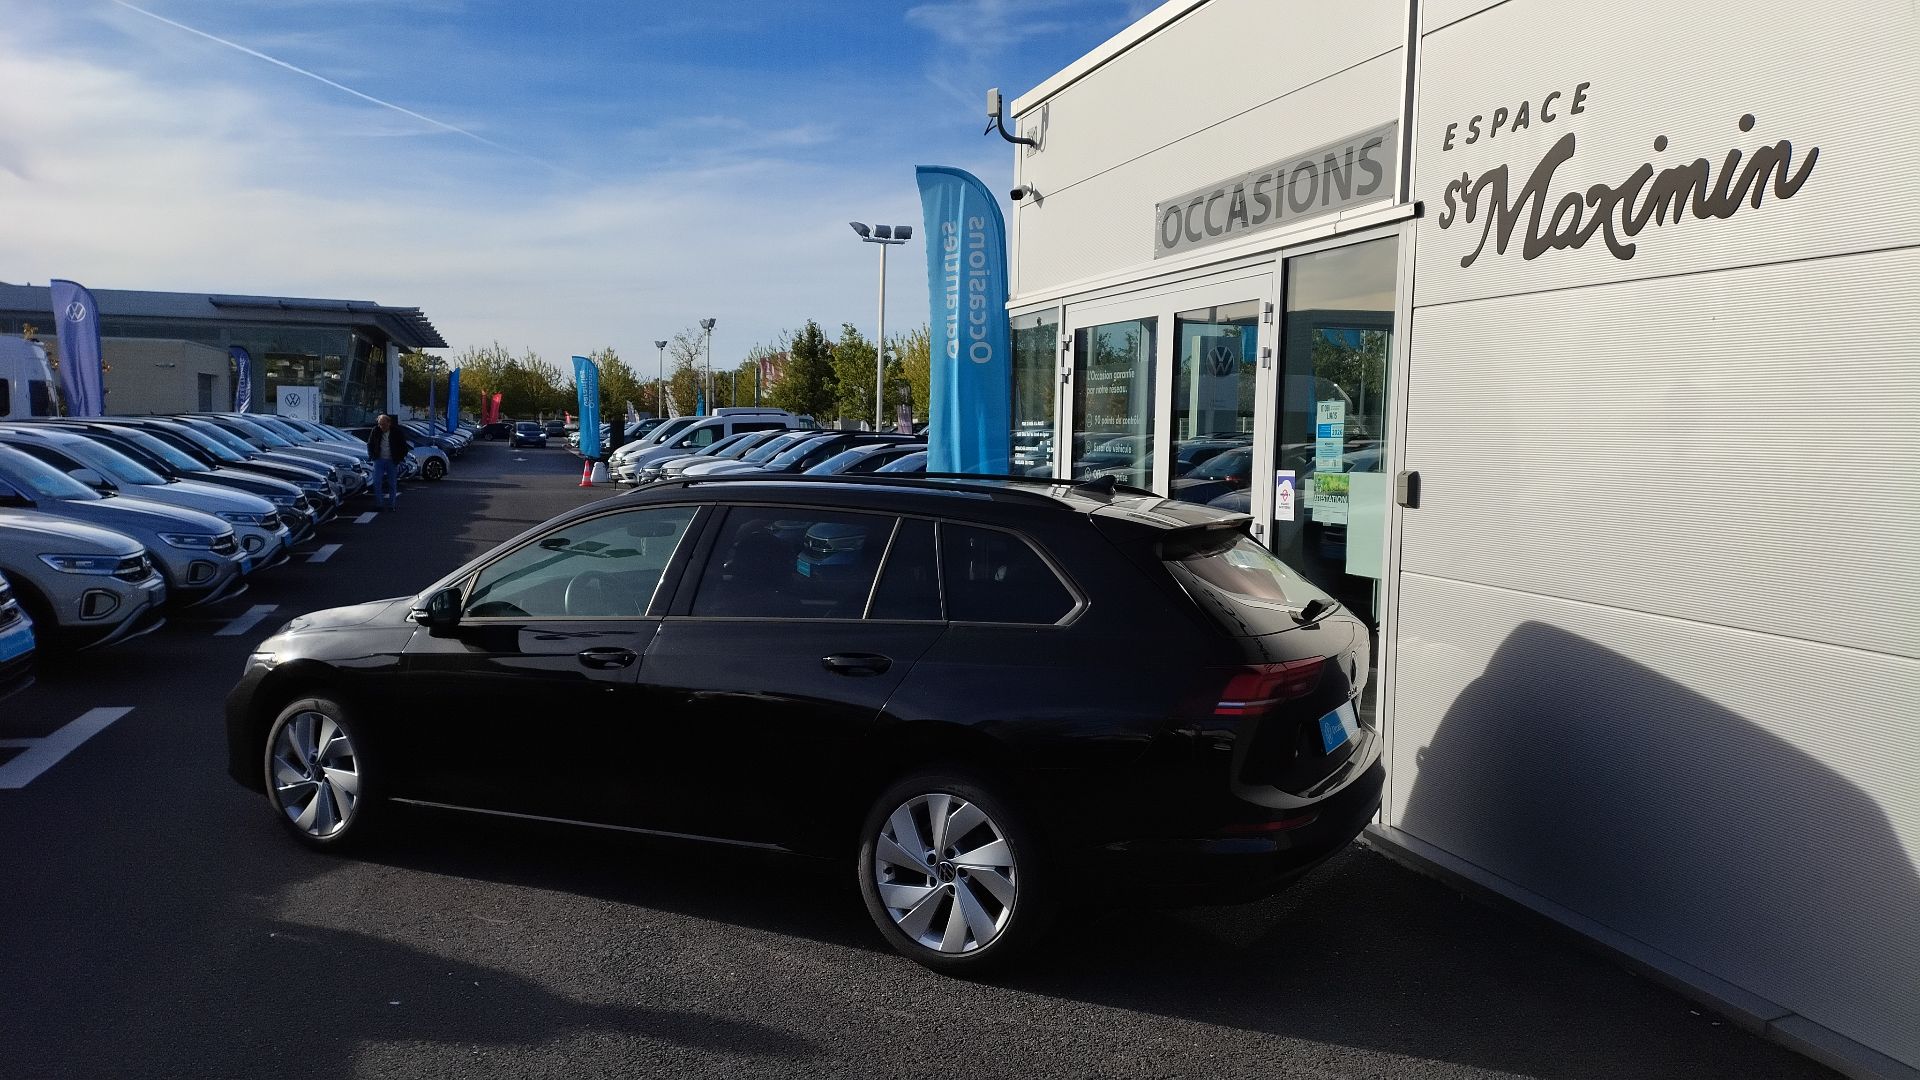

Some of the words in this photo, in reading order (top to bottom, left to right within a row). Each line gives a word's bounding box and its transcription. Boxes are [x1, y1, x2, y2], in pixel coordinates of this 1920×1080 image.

[1442, 81, 1591, 152] ESPACE
[1161, 136, 1384, 249] OCCASIONS
[1438, 171, 1473, 230] St
[1460, 113, 1820, 268] Maximin
